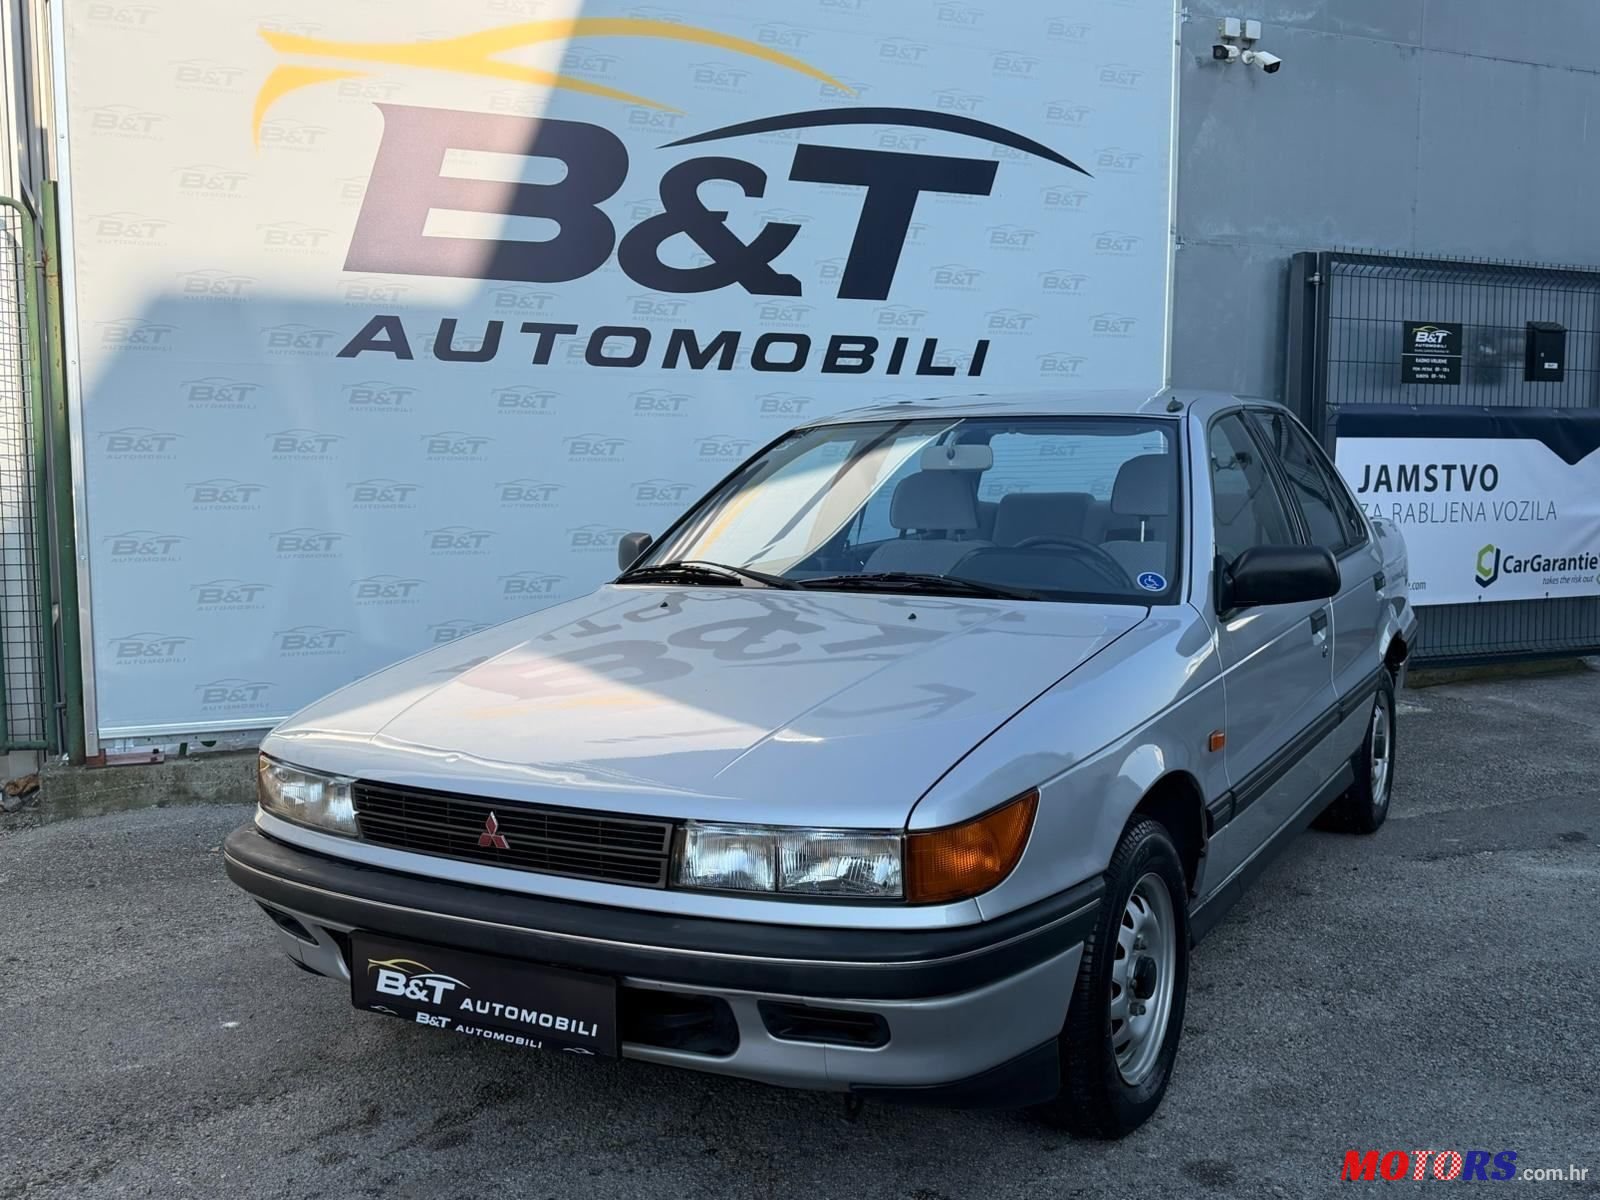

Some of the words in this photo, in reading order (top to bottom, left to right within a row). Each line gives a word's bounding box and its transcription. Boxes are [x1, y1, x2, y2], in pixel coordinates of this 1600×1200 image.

[937, 7, 984, 26] B&T
[757, 28, 809, 46] B&T
[1047, 22, 1091, 38] B&T
[879, 43, 927, 60] B&T
[558, 53, 616, 72] B&T
[993, 57, 1038, 73] B&T
[174, 66, 244, 86] B&T
[693, 69, 747, 86] B&T
[1099, 69, 1141, 85] B&T
[937, 96, 982, 113] B&T
[628, 110, 683, 127] B&T
[1046, 106, 1090, 121] B&T
[91, 112, 162, 132] B&T
[259, 126, 325, 145] B&T
[1097, 153, 1139, 168] B&T
[179, 172, 247, 191] B&T
[343, 102, 999, 300] B&T
[1044, 192, 1087, 206] B&T
[96, 220, 167, 238] B&T
[263, 229, 329, 246] B&T
[990, 231, 1034, 245] B&T
[1095, 237, 1137, 251] B&T
[184, 277, 252, 294] B&T
[934, 271, 980, 285] B&T
[1042, 276, 1085, 289] B&T
[345, 286, 408, 302] B&T
[494, 293, 553, 309] B&T
[632, 300, 686, 315] B&T
[759, 306, 809, 321] B&T
[877, 312, 924, 325] B&T
[988, 316, 1032, 329] B&T
[1093, 319, 1134, 332] B&T
[101, 326, 172, 343] B&T
[267, 332, 332, 348] B&T
[1416, 332, 1447, 343] B&T
[337, 314, 989, 377] AUTOMOBILI
[1040, 359, 1083, 371] B&T
[188, 386, 256, 401] B&T
[349, 390, 411, 404] B&T
[498, 393, 556, 407] B&T
[634, 397, 688, 410] B&T
[760, 399, 810, 412] B&T
[106, 436, 176, 451] B&T
[272, 438, 337, 452] B&T
[427, 440, 487, 454] B&T
[569, 441, 624, 455] B&T
[698, 442, 750, 455] B&T
[1357, 464, 1499, 493] JAMSTVO
[193, 488, 260, 502] B&T
[353, 488, 415, 501] B&T
[501, 487, 558, 501] B&T
[635, 487, 689, 500] B&T
[1392, 501, 1487, 524] RABLJENA
[1493, 500, 1558, 522] VOZILA
[111, 539, 181, 555] B&T
[277, 536, 341, 551] B&T
[430, 534, 490, 549] B&T
[1502, 552, 1597, 574] CarGarantie
[503, 579, 560, 593] B&T
[1542, 576, 1559, 585] takes
[1560, 575, 1571, 584] the
[198, 587, 264, 603] B&T
[357, 583, 418, 598] B&T
[116, 640, 185, 657] B&T
[281, 633, 344, 649] B&T
[202, 686, 268, 703] B&T
[376, 968, 455, 1004] B&T
[460, 998, 598, 1037] AUTOMOBILI
[416, 1012, 451, 1028] B&T
[455, 1024, 542, 1049] AUTOMOBILI
